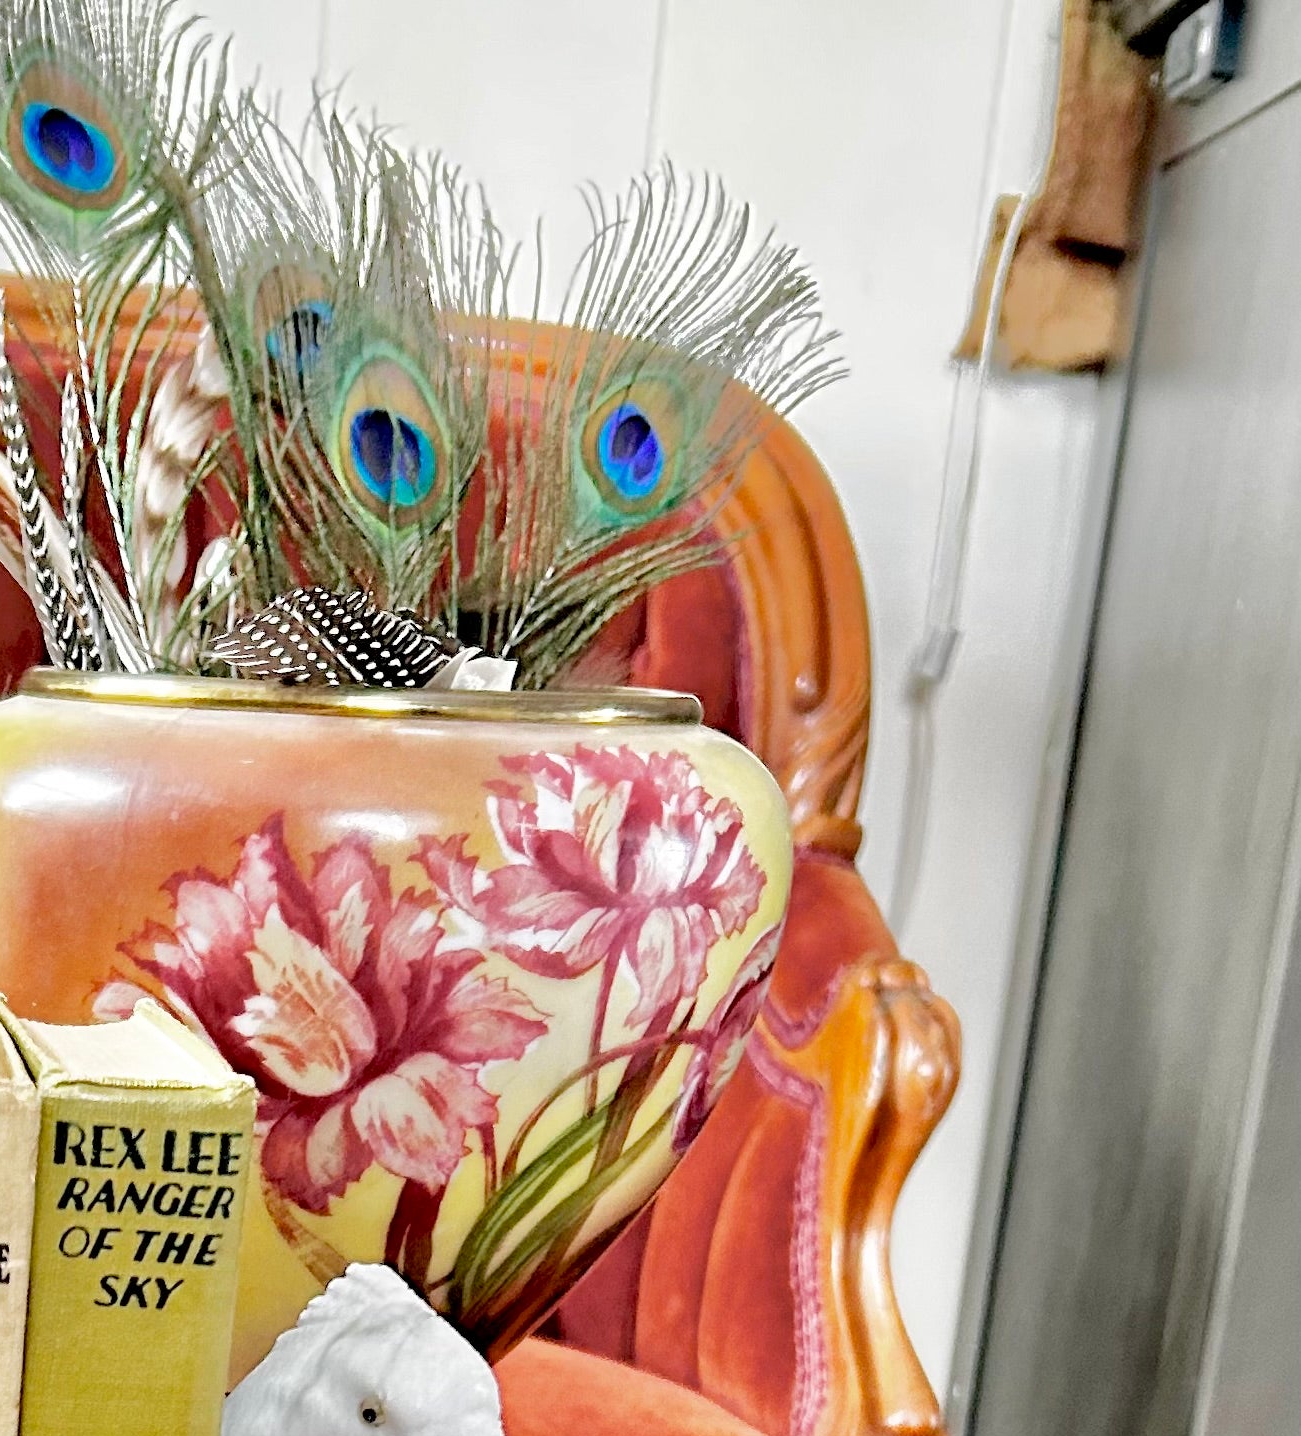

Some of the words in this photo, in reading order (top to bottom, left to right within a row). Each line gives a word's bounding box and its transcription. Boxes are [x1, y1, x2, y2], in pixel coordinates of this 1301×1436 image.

[53, 1121, 145, 1170] REX
[161, 1129, 244, 1176] LEE
[56, 1176, 236, 1220] RANGER
[58, 1225, 122, 1259] OF
[133, 1229, 223, 1266] THE
[93, 1274, 185, 1310] SKY
